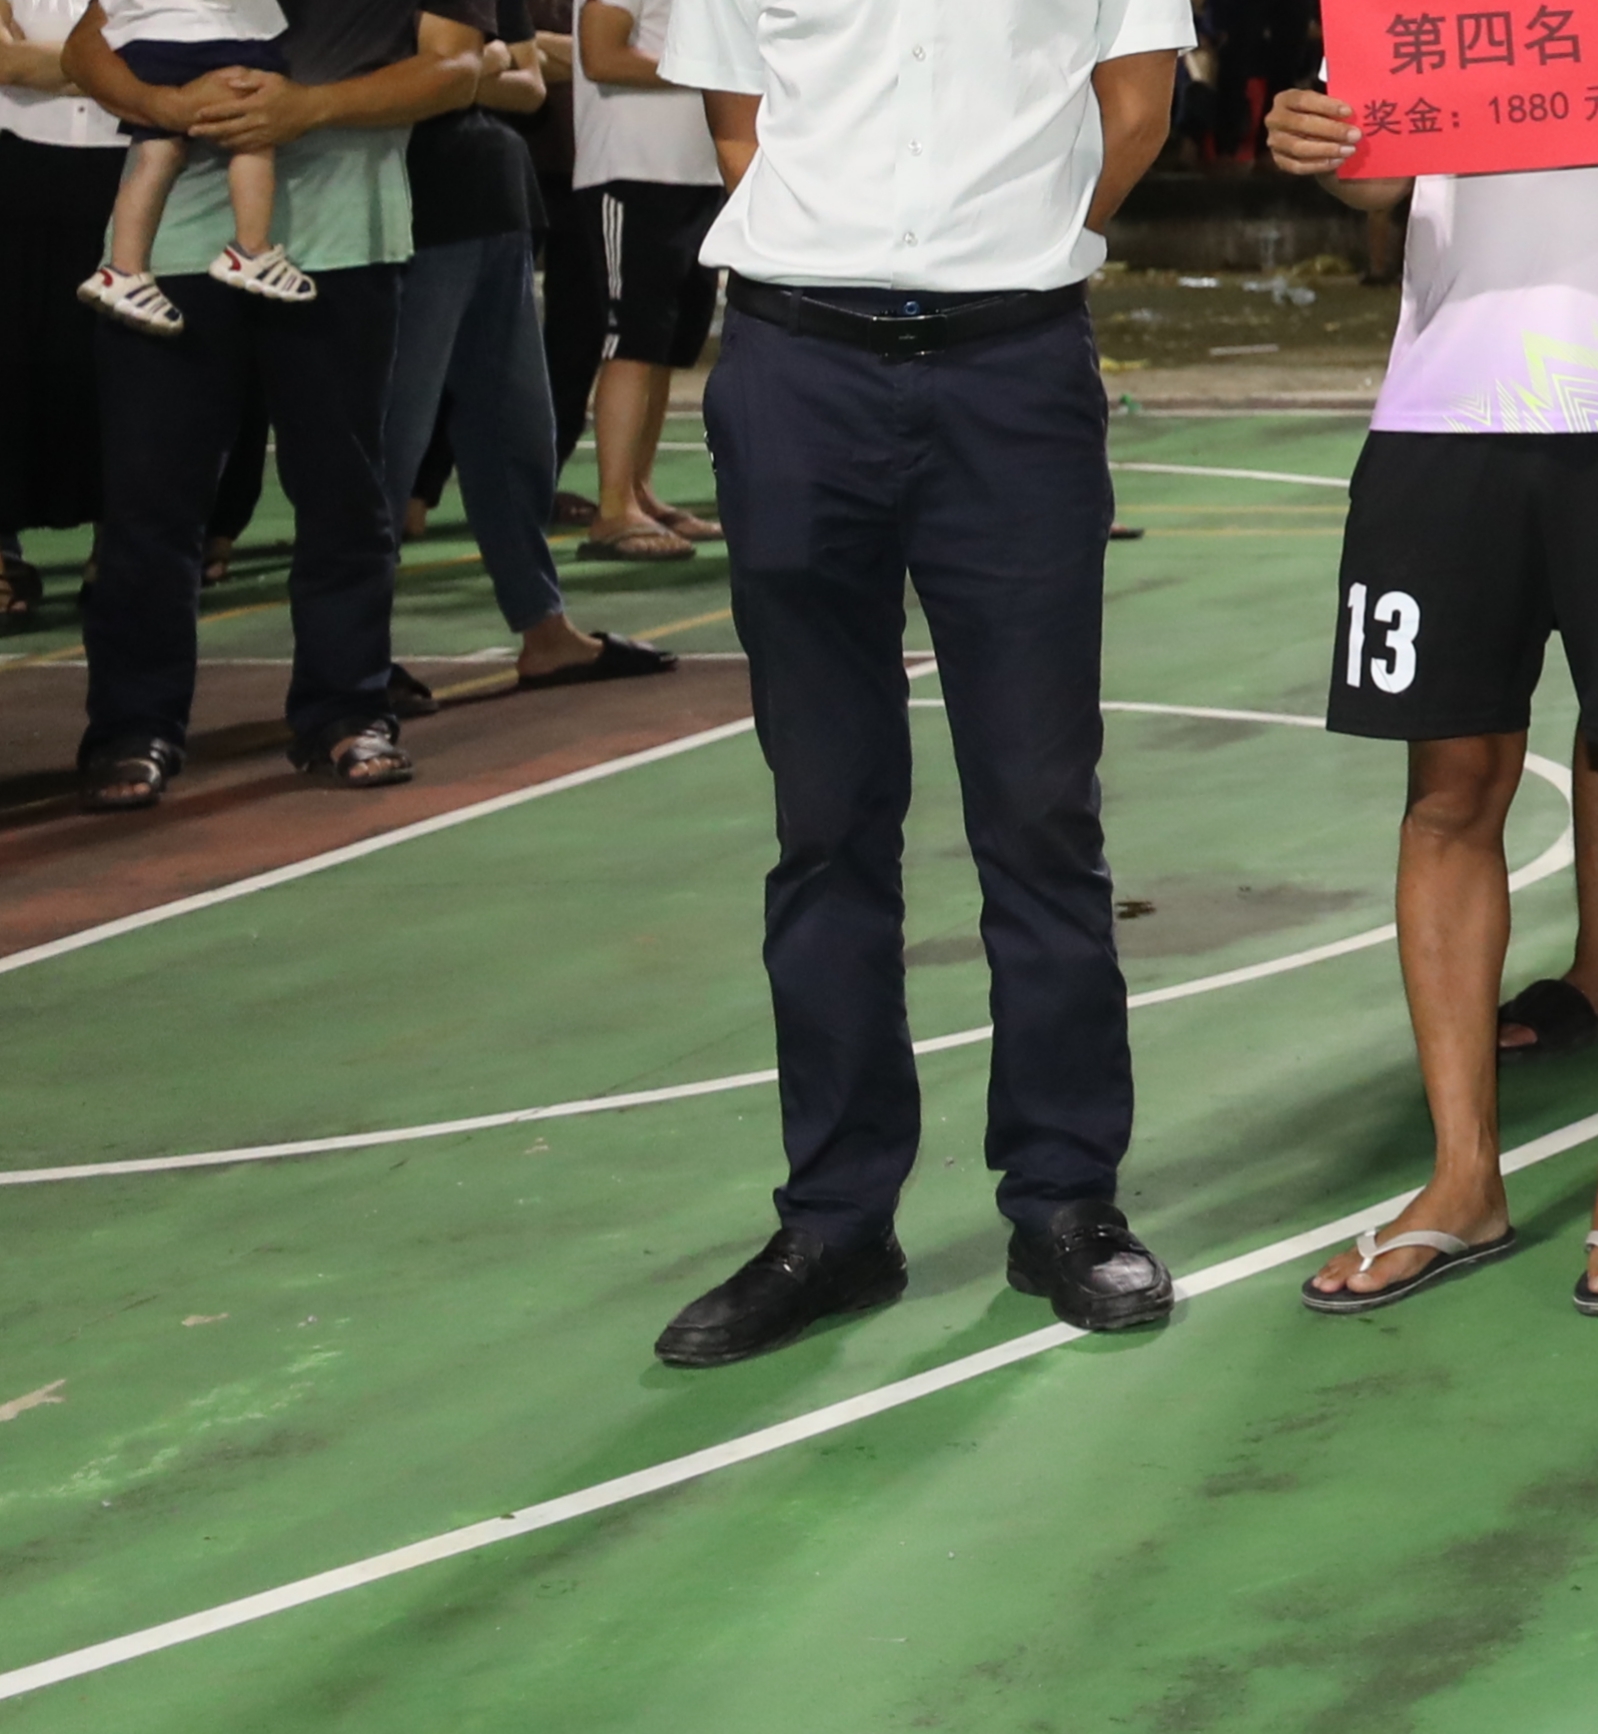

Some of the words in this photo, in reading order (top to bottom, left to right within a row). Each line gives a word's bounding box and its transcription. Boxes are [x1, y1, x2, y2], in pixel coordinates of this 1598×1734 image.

[1386, 4, 1582, 75] 第四名
[1345, 581, 1421, 695] 13
